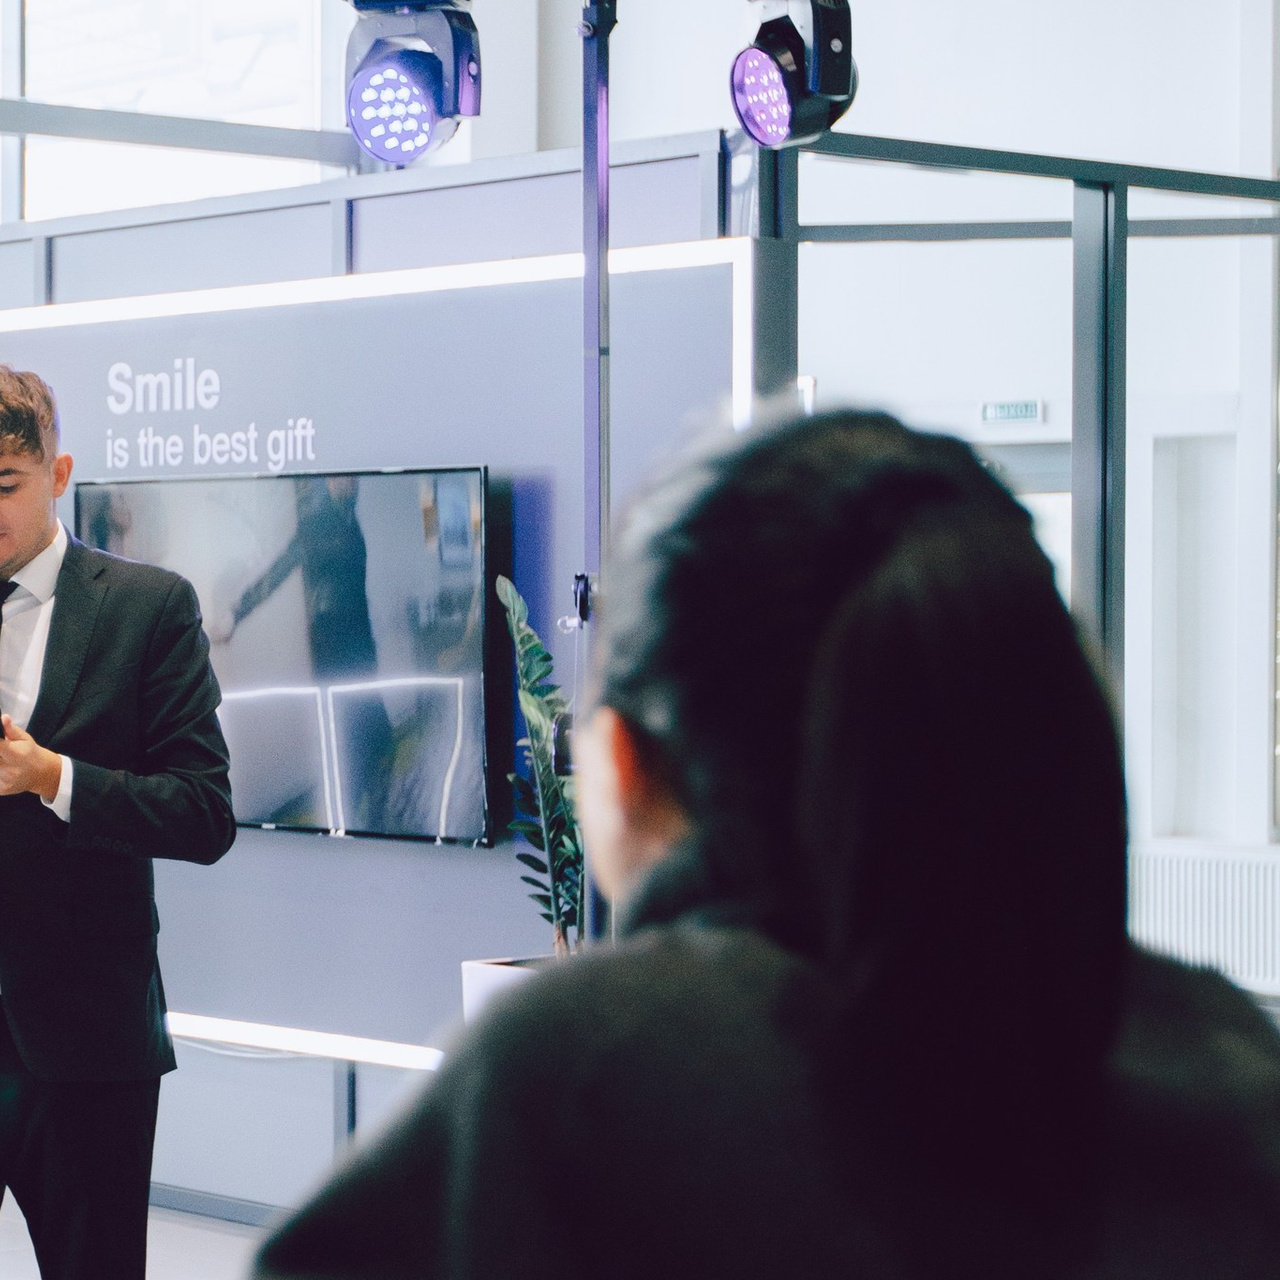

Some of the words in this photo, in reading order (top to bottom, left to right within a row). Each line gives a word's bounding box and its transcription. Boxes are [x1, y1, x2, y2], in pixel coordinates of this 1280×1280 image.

[106, 357, 220, 415] Smile
[106, 428, 129, 469] is
[137, 426, 184, 467] the
[193, 422, 258, 464] best
[267, 417, 316, 471] gift
